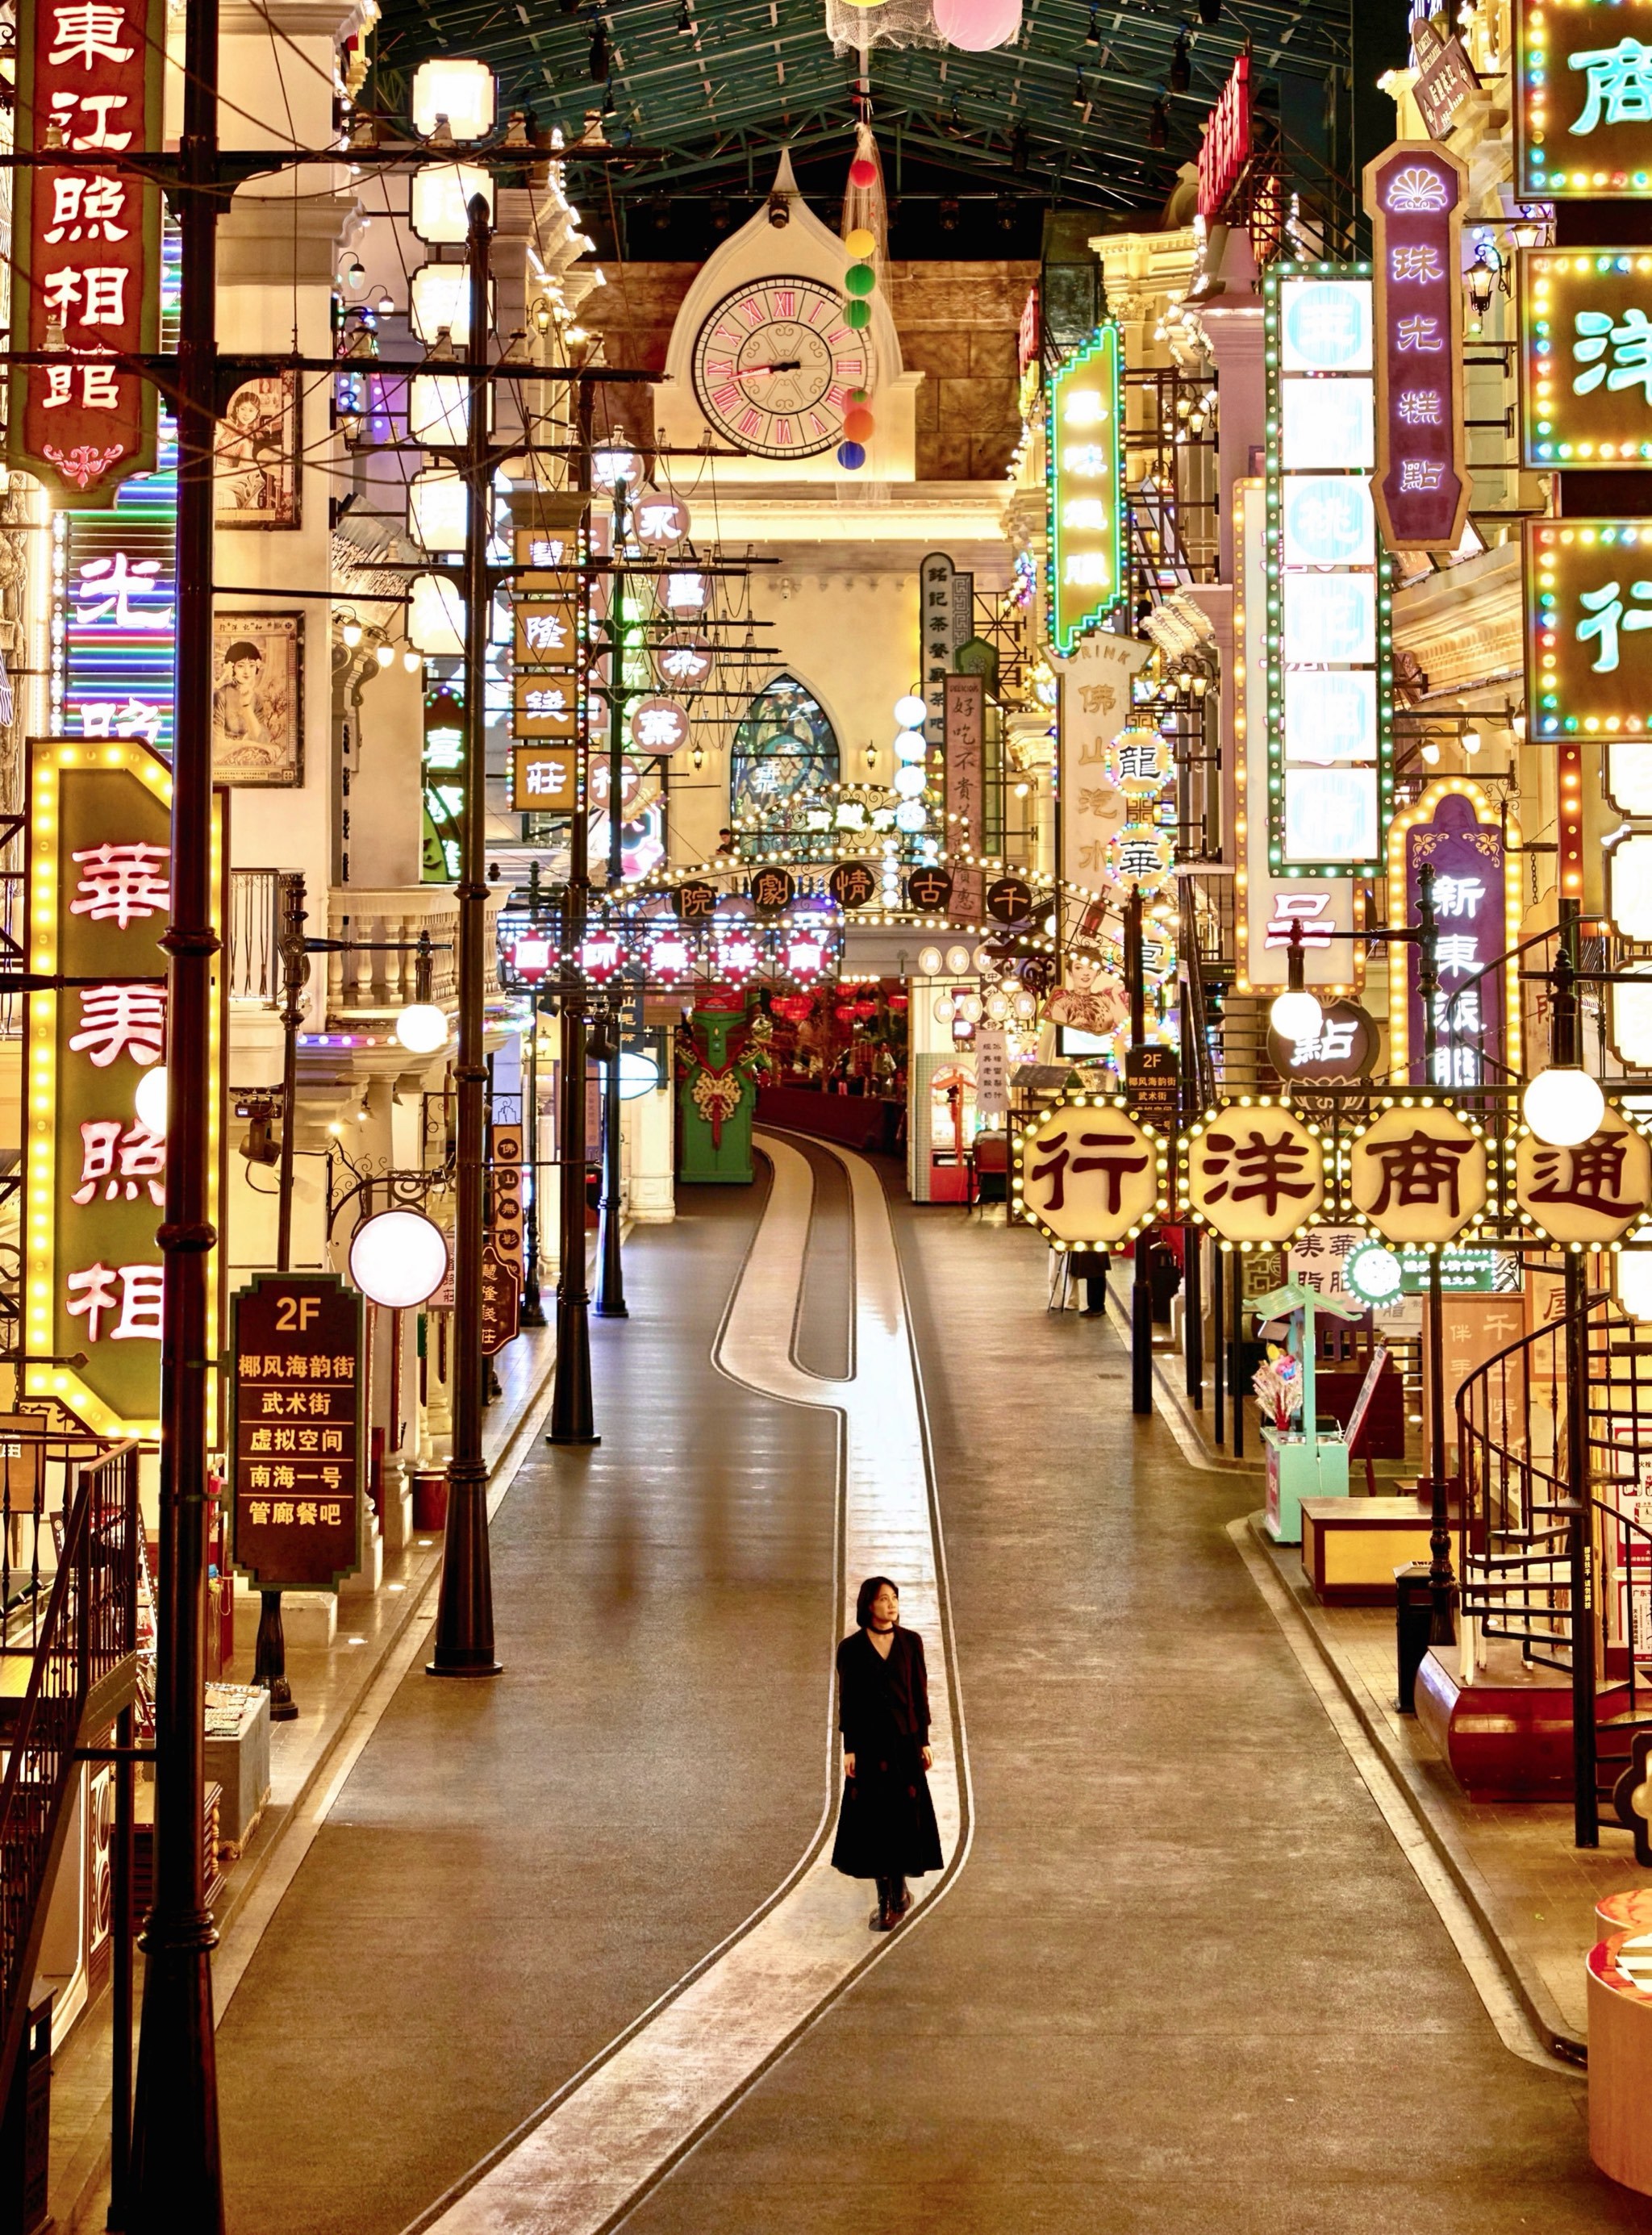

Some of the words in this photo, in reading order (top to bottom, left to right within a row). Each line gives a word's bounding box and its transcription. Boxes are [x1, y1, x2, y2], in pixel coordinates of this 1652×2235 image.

[1392, 244, 1446, 493] 珠光糕點
[1075, 684, 1120, 874] 佛山汽水
[1143, 1053, 1162, 1068] 2F
[276, 1297, 321, 1331] 2F
[239, 1355, 355, 1379] 椰风海韵街
[262, 1391, 332, 1416] 武术街
[250, 1428, 343, 1452] 虚拟空间
[249, 1466, 343, 1490] 南海一号
[248, 1502, 342, 1526] 管廊餐吧
